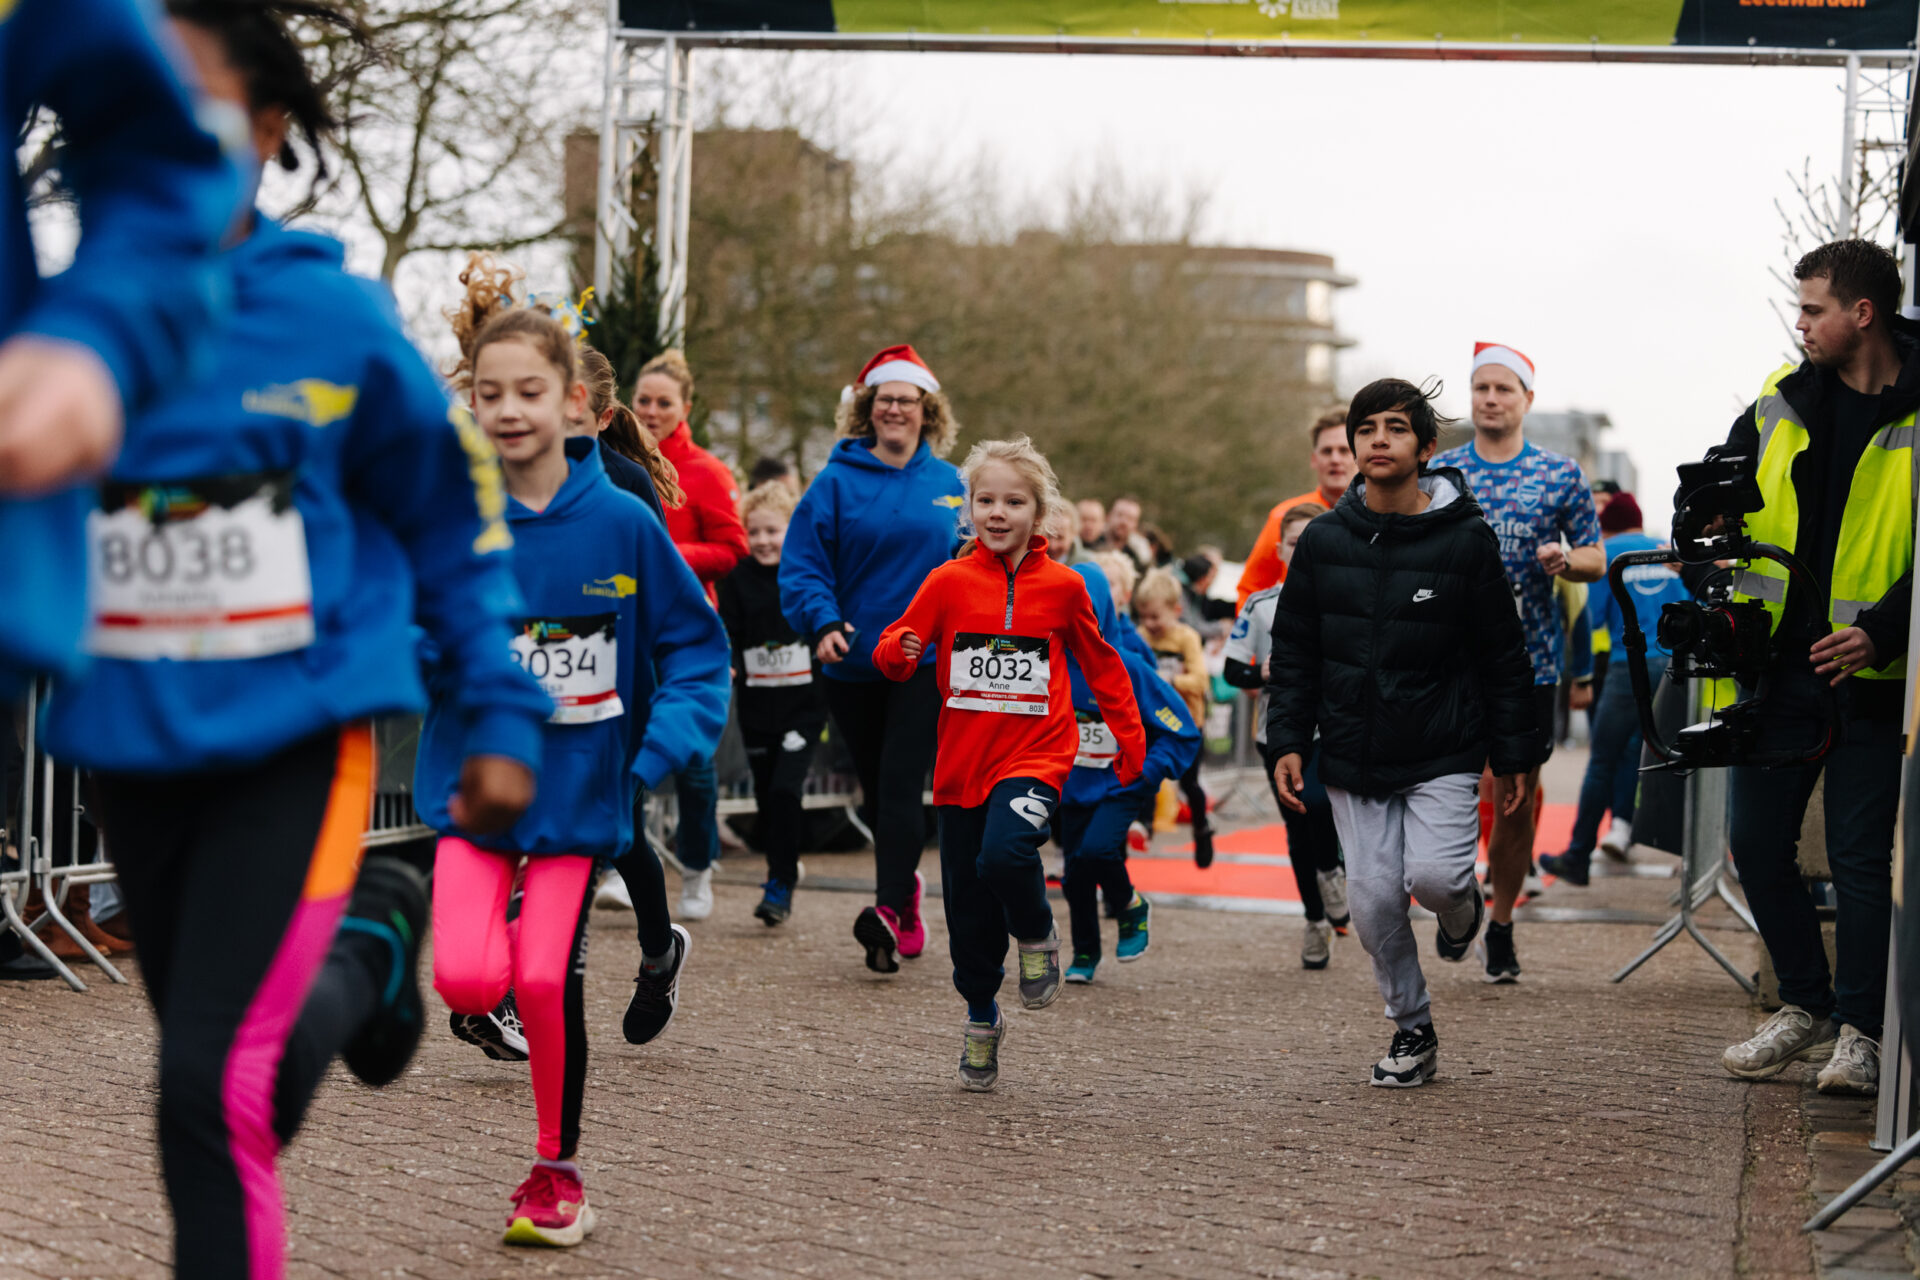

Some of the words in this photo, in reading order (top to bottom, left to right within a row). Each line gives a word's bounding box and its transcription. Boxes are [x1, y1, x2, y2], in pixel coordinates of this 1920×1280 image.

[102, 526, 255, 583] 8038
[969, 656, 1032, 681] 8032
[989, 681, 1010, 690] Anne
[1029, 704, 1044, 713] 8032
